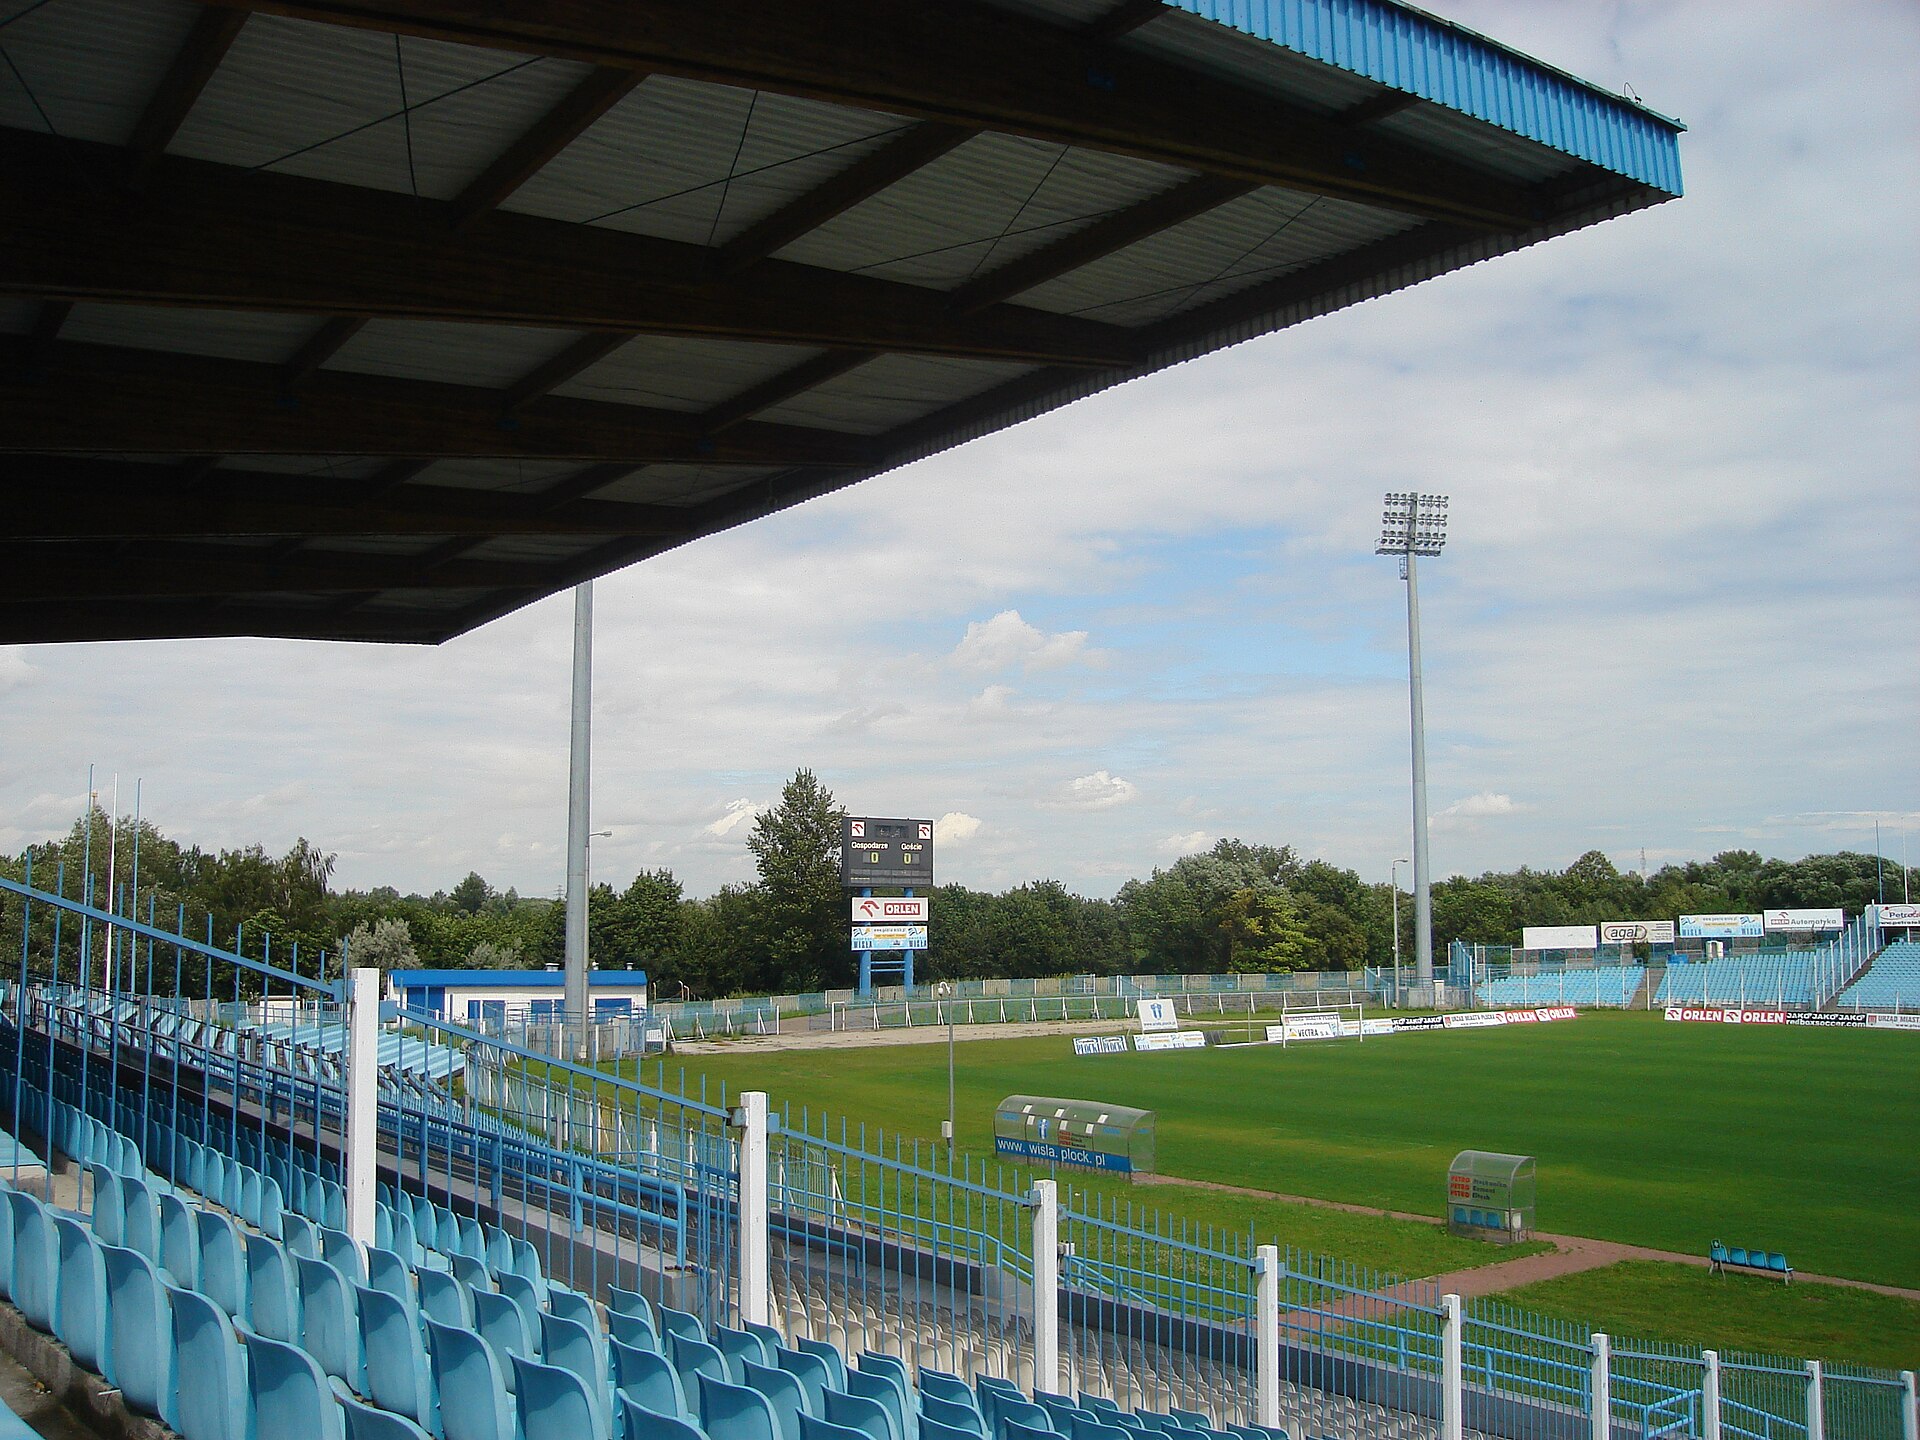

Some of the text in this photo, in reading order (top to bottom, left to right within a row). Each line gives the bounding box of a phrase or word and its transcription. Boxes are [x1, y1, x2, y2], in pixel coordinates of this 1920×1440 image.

[851, 842, 889, 850] Gospodarze
[885, 904, 919, 914] ORLEN
[1791, 918, 1837, 926] Automatyka
[1506, 1011, 1537, 1022] ORLEN
[1549, 1008, 1576, 1019] ORLEN
[1682, 1011, 1721, 1021] ORLEN
[1742, 1012, 1784, 1023] ORLEN
[1786, 1019, 1866, 1027] redboxsoccer.com
[1298, 1028, 1319, 1037] VECTRA
